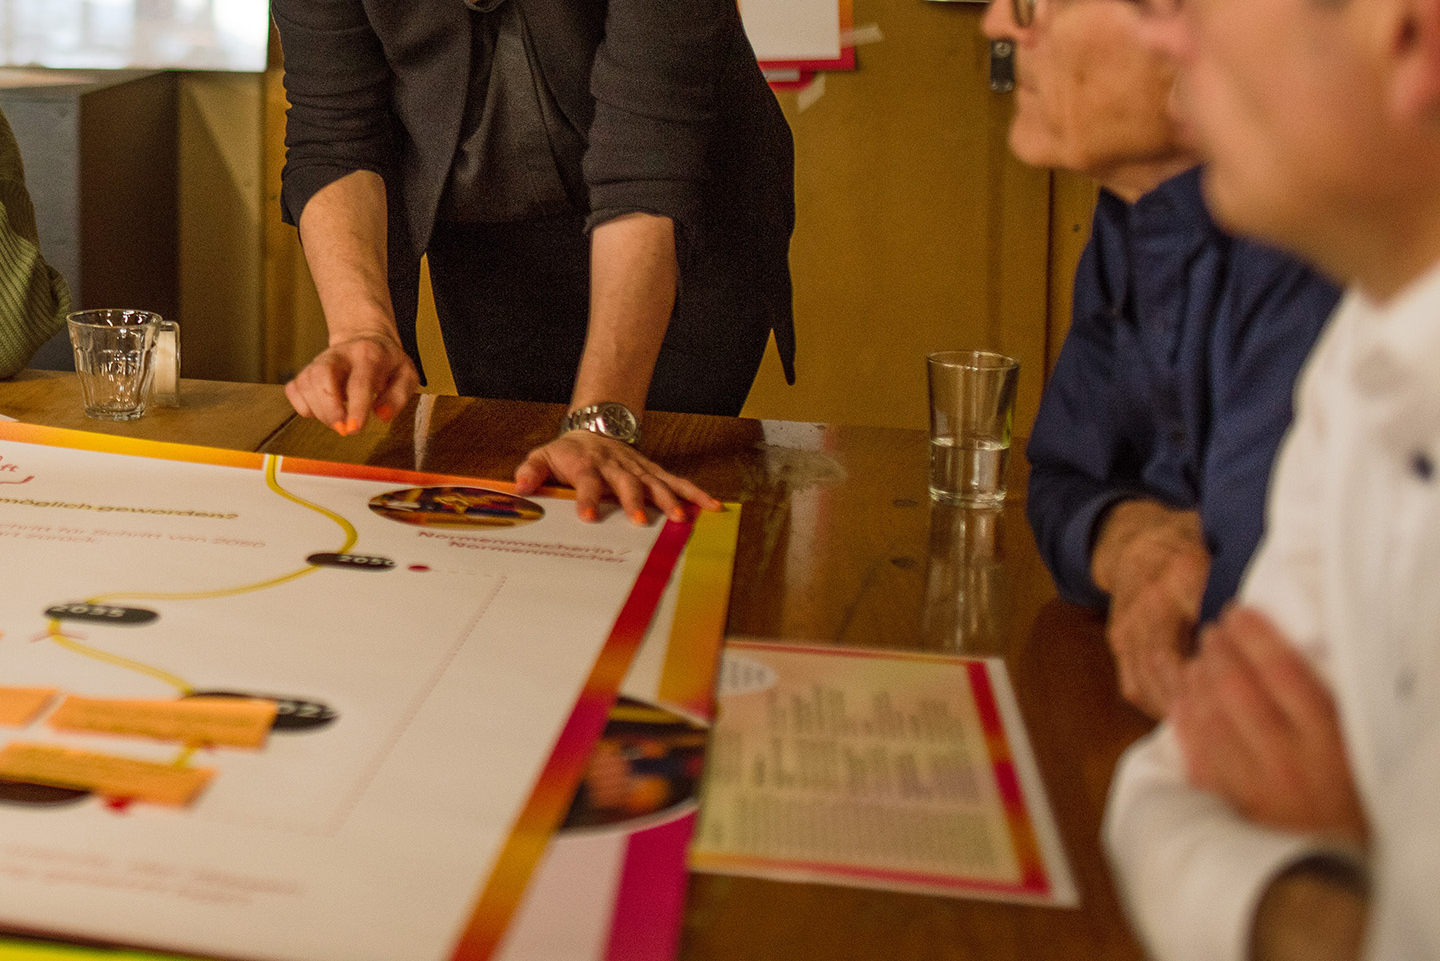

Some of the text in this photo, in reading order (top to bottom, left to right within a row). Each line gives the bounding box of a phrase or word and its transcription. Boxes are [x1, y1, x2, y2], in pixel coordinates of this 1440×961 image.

[96, 505, 239, 519] geworden?
[92, 528, 162, 540] Schritt
[169, 535, 208, 543] von
[417, 530, 615, 556] Normenmacherin
[448, 540, 629, 565] Normenmacher
